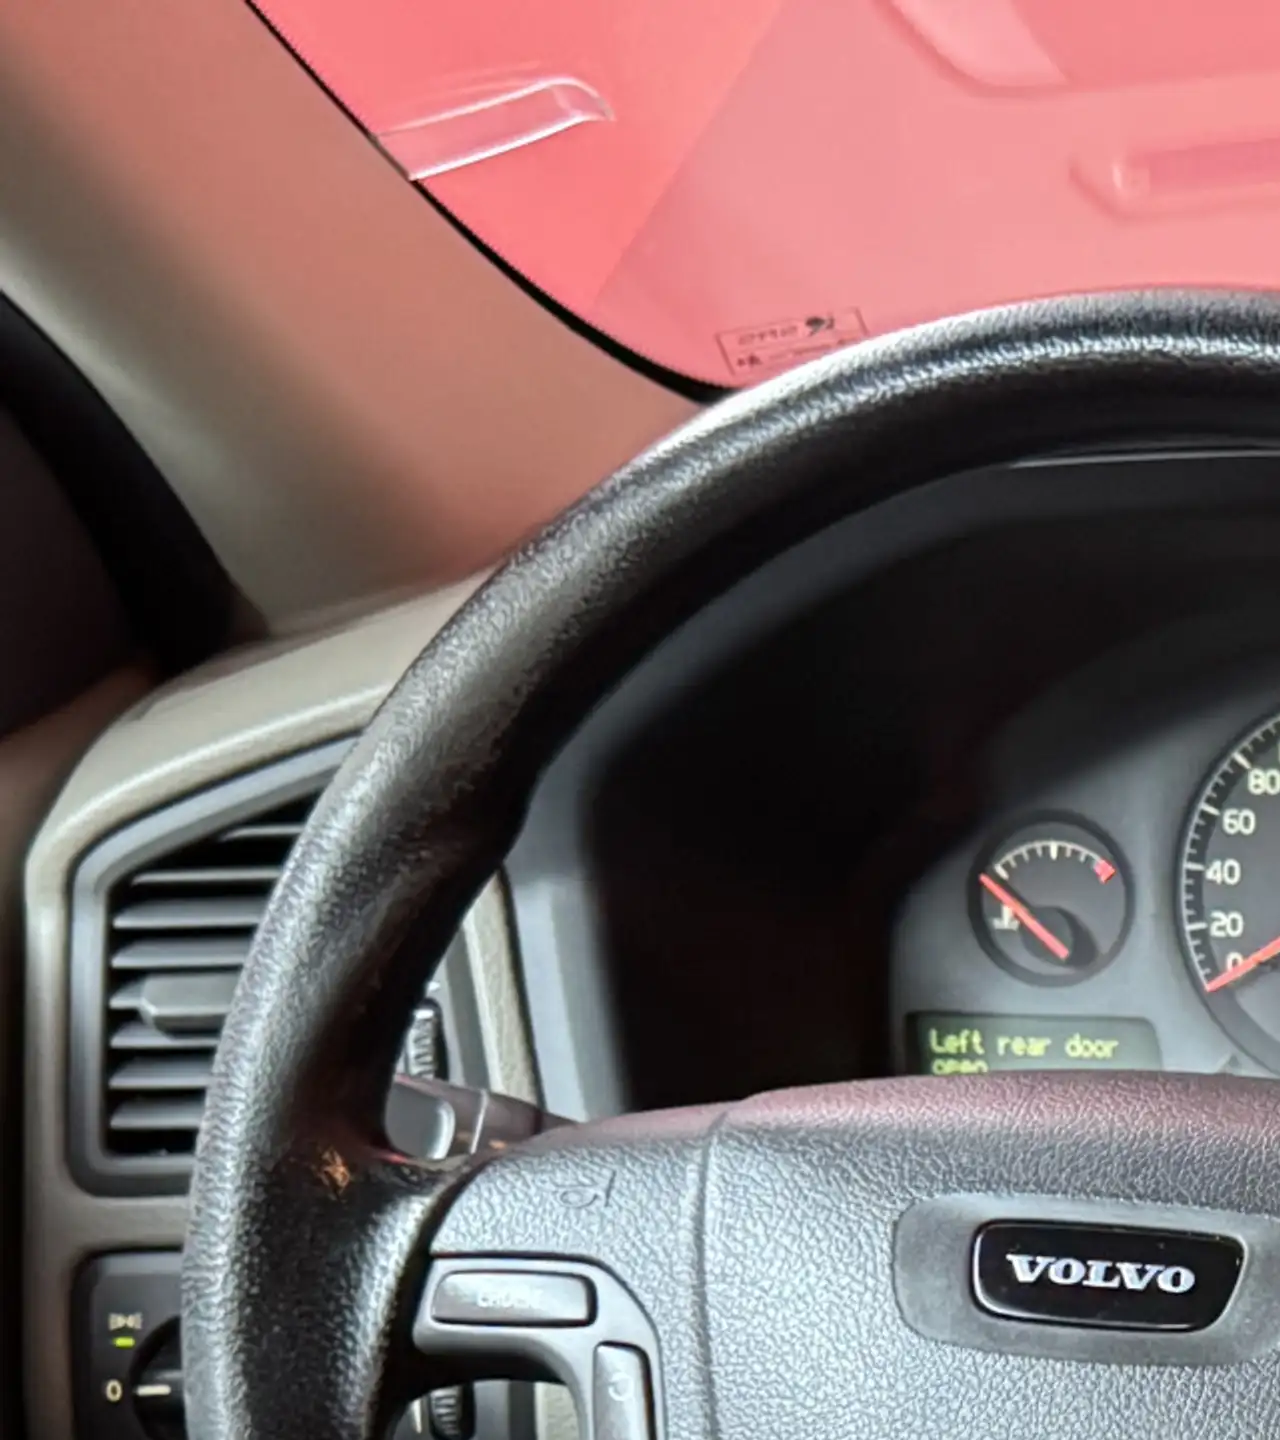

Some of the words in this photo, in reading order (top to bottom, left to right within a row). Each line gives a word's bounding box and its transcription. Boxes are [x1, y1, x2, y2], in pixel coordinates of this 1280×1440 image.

[1223, 808, 1256, 836] 60
[1206, 859, 1241, 885] 40
[1210, 912, 1244, 938] 20
[930, 1027, 985, 1055] Left
[997, 1035, 1052, 1056] rear
[1065, 1032, 1120, 1059] door
[1006, 1253, 1196, 1294] VOLVO
[106, 1379, 123, 1402] 0
